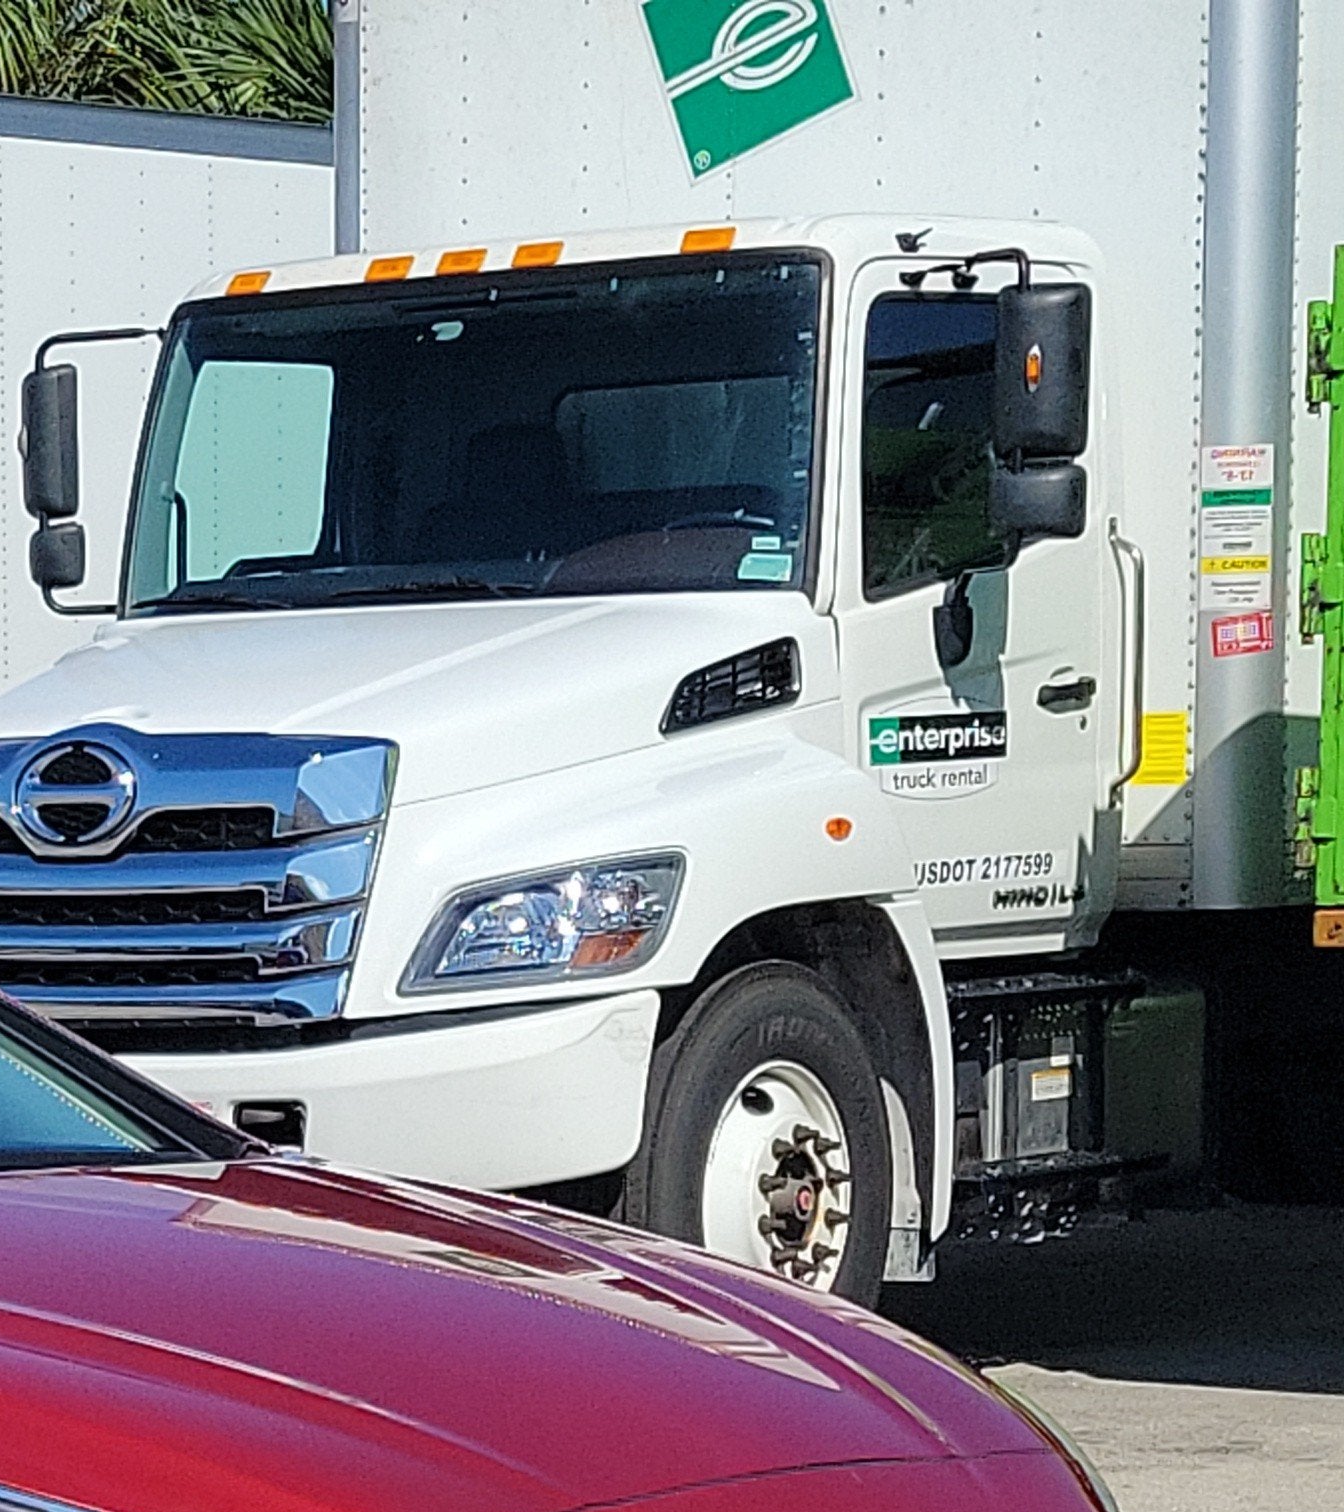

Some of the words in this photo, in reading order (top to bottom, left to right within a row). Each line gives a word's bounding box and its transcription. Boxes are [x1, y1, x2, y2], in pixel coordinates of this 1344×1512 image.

[871, 718, 1006, 756] enterprise
[892, 767, 937, 791] truck
[941, 763, 988, 787] rental
[914, 858, 977, 887] USDOT
[980, 852, 1054, 881] 2177599
